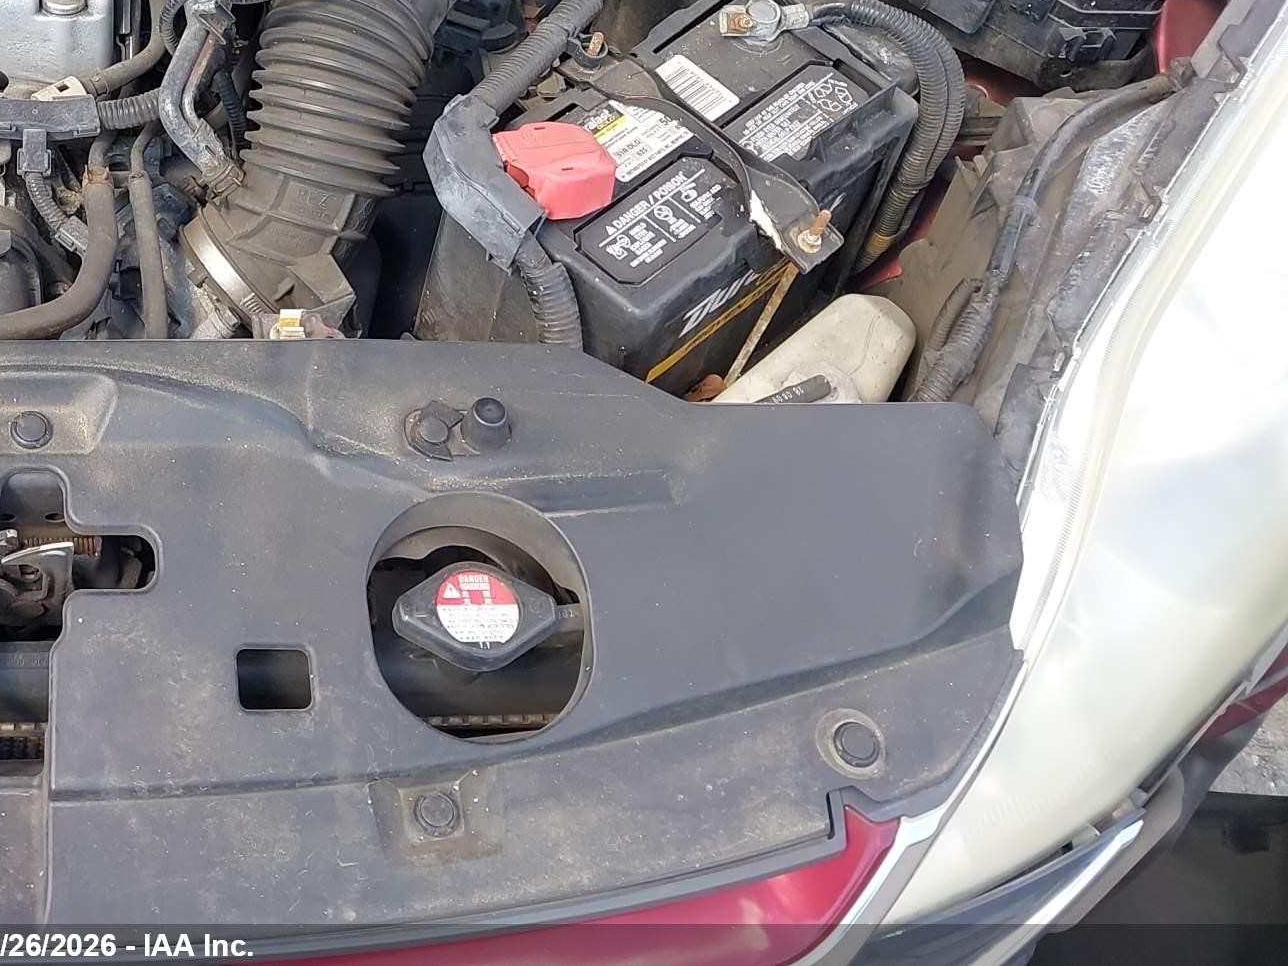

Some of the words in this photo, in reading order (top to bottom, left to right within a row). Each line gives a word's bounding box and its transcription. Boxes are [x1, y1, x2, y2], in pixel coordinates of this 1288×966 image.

[583, 109, 610, 131] ralast
[659, 115, 672, 127] 50
[612, 200, 650, 229] DANGER
[653, 173, 687, 200] POISON
